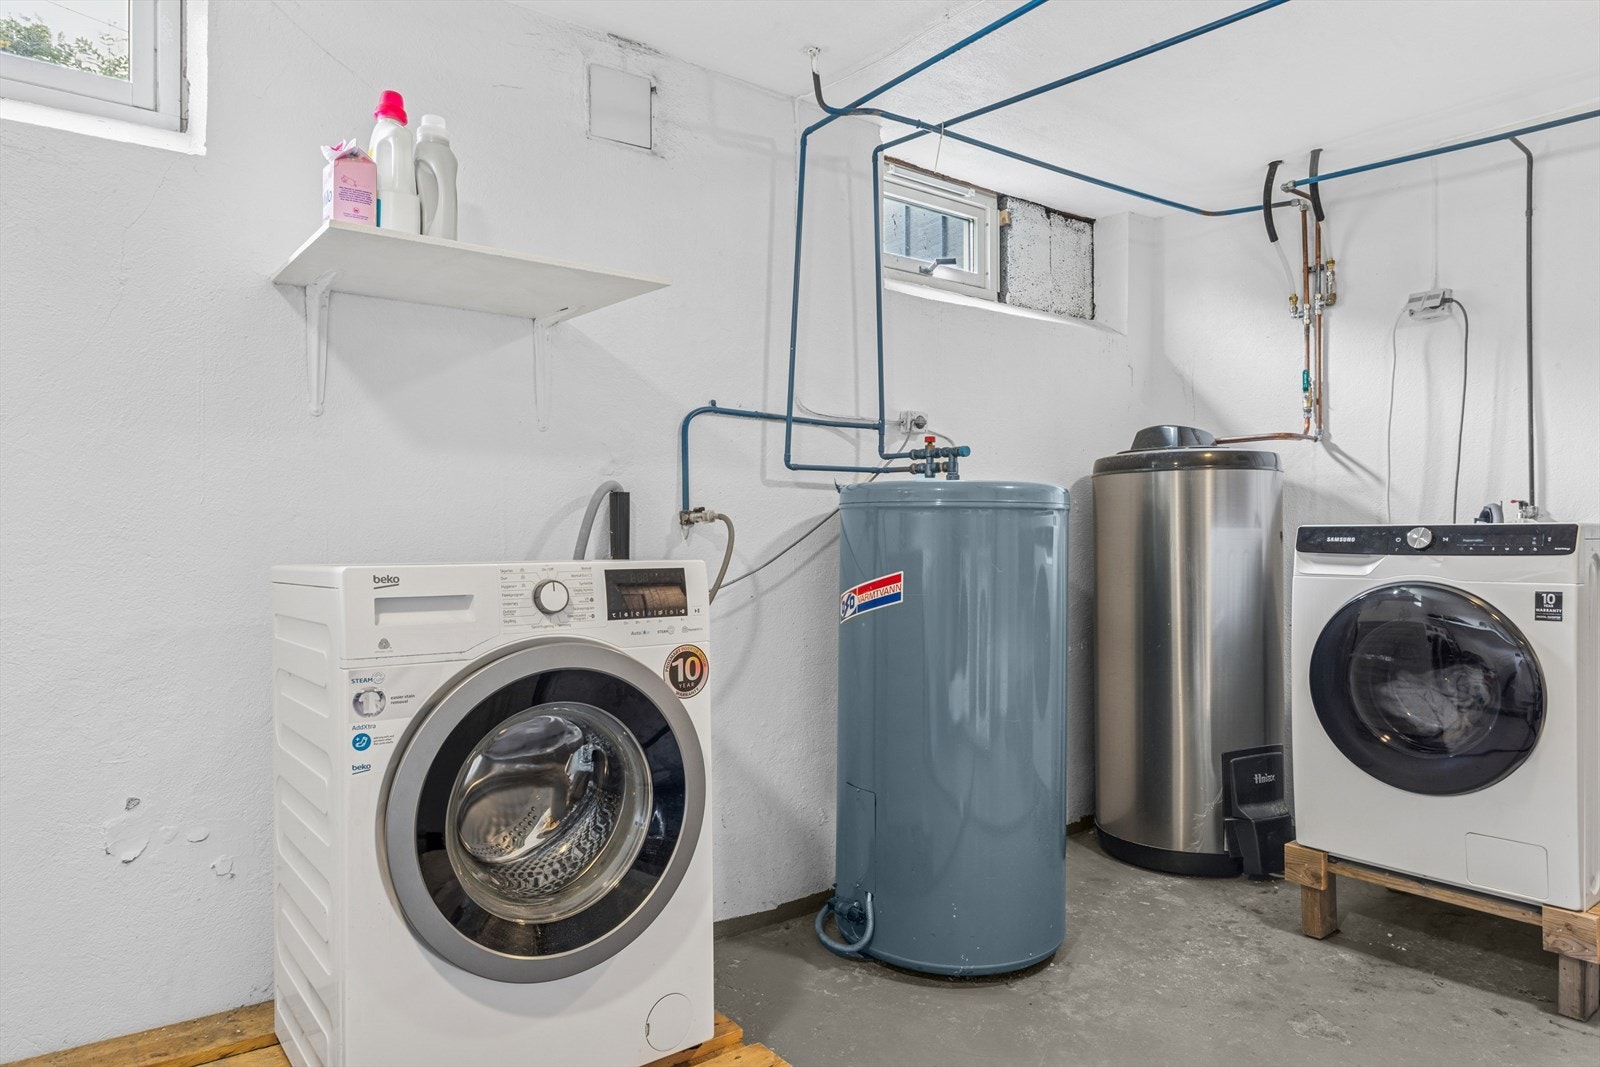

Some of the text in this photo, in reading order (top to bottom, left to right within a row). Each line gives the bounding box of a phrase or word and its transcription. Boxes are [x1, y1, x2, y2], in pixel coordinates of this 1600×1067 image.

[373, 574, 400, 585] beko
[858, 584, 902, 603] VARMTVANN
[1541, 593, 1556, 604] 10
[671, 656, 701, 683] 10
[675, 687, 699, 697] WARRANTY
[352, 723, 376, 731] AddXtra
[352, 763, 372, 772] beko
